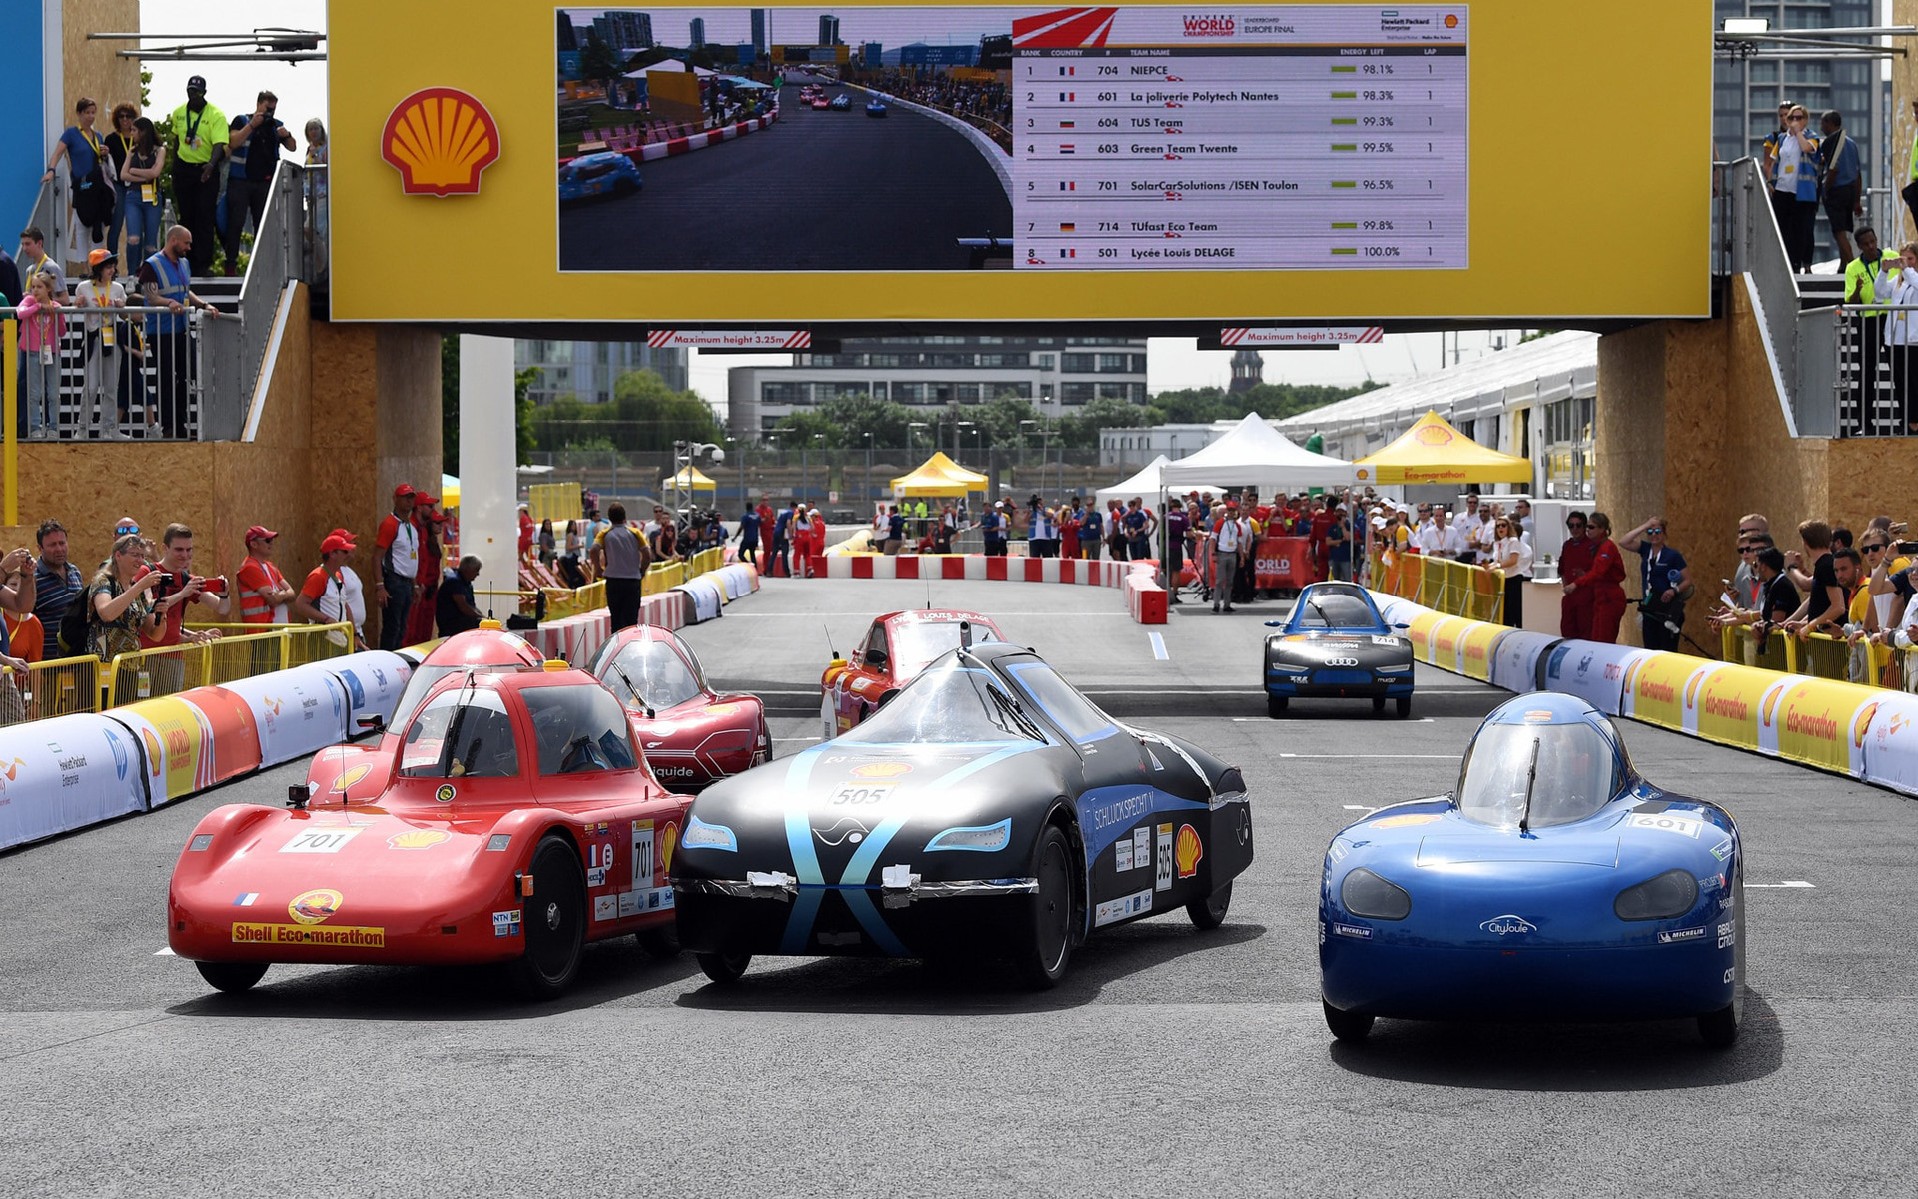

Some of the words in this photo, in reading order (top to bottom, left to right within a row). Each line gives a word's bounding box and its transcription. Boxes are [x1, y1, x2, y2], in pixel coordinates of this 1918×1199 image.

[1183, 20, 1235, 30] WORLD
[1130, 49, 1149, 57] TEAM
[1150, 49, 1171, 57] NAME
[1027, 66, 1033, 76] 1
[1097, 66, 1119, 76] 704
[1130, 65, 1168, 75] NIEPCE
[1362, 65, 1394, 75] 98.1%
[1427, 64, 1433, 74] 1
[1027, 92, 1035, 102] 2
[1097, 92, 1118, 102] 601
[1130, 92, 1144, 102] La
[1146, 91, 1190, 103] joliverie
[1192, 91, 1238, 103] Polytech
[1240, 91, 1279, 102] Nantes
[1362, 91, 1394, 101] 98.3%
[1427, 90, 1433, 100] 1
[1027, 118, 1035, 128] 3
[1097, 118, 1119, 128] 604
[1130, 118, 1151, 128] TUS
[1154, 118, 1184, 128] Team
[1362, 117, 1394, 127] 99.3%
[1427, 116, 1433, 126] 1
[1027, 144, 1035, 154] 4
[1097, 144, 1119, 154] 603
[1130, 144, 1164, 154] Green
[1167, 144, 1196, 154] Team
[1199, 144, 1238, 154] Twente
[1362, 143, 1394, 153] 99.5%
[1427, 142, 1433, 152] 1
[1028, 181, 1035, 191] 5
[1098, 181, 1118, 191] 701
[1130, 181, 1226, 191] SolarCarSolutions
[1228, 180, 1259, 191] /ISEN
[1262, 180, 1299, 191] Toulon
[1362, 180, 1394, 190] 96.5%
[1427, 180, 1433, 190] 1
[1028, 222, 1035, 232] 7
[1098, 222, 1119, 232] 714
[1130, 221, 1165, 232] TUfast
[1168, 222, 1186, 232] Eco
[1189, 222, 1218, 232] Team
[1362, 220, 1394, 231] 99.8%
[1427, 220, 1433, 230] 1
[1028, 249, 1035, 258] 8
[1098, 249, 1119, 258] 501
[1131, 248, 1161, 259] Lycée
[1164, 248, 1191, 258] Louis
[1194, 248, 1235, 258] DELAGE
[1364, 247, 1400, 257] 100.0%
[1427, 247, 1433, 256] 1
[674, 335, 721, 344] Maximum
[723, 335, 753, 346] height
[755, 336, 785, 344] 3.25m
[1247, 333, 1295, 341] Maximum
[1297, 332, 1326, 343] height
[1328, 332, 1358, 340] 3.25m
[1404, 470, 1466, 481] Eco-marathon
[1255, 559, 1290, 570] ORLD
[956, 612, 990, 622] DELAGE
[1640, 672, 1675, 704] Eco-marathon
[1705, 687, 1748, 722] Eco-marathon
[1787, 703, 1838, 742] Eco-marathon
[165, 727, 191, 758] WORLD
[652, 766, 694, 777] iquide
[833, 789, 886, 805] 505
[1094, 792, 1149, 830] SCHLUCKSPECHT
[1148, 790, 1155, 809] V
[1637, 815, 1688, 832] 601
[293, 833, 346, 848] 701
[634, 840, 652, 879] 701
[1158, 843, 1171, 881] 505
[493, 913, 509, 923] NTN
[235, 924, 273, 942] Shell
[1341, 925, 1370, 937] MICHELIN
[1671, 927, 1704, 939] MICHELIN
